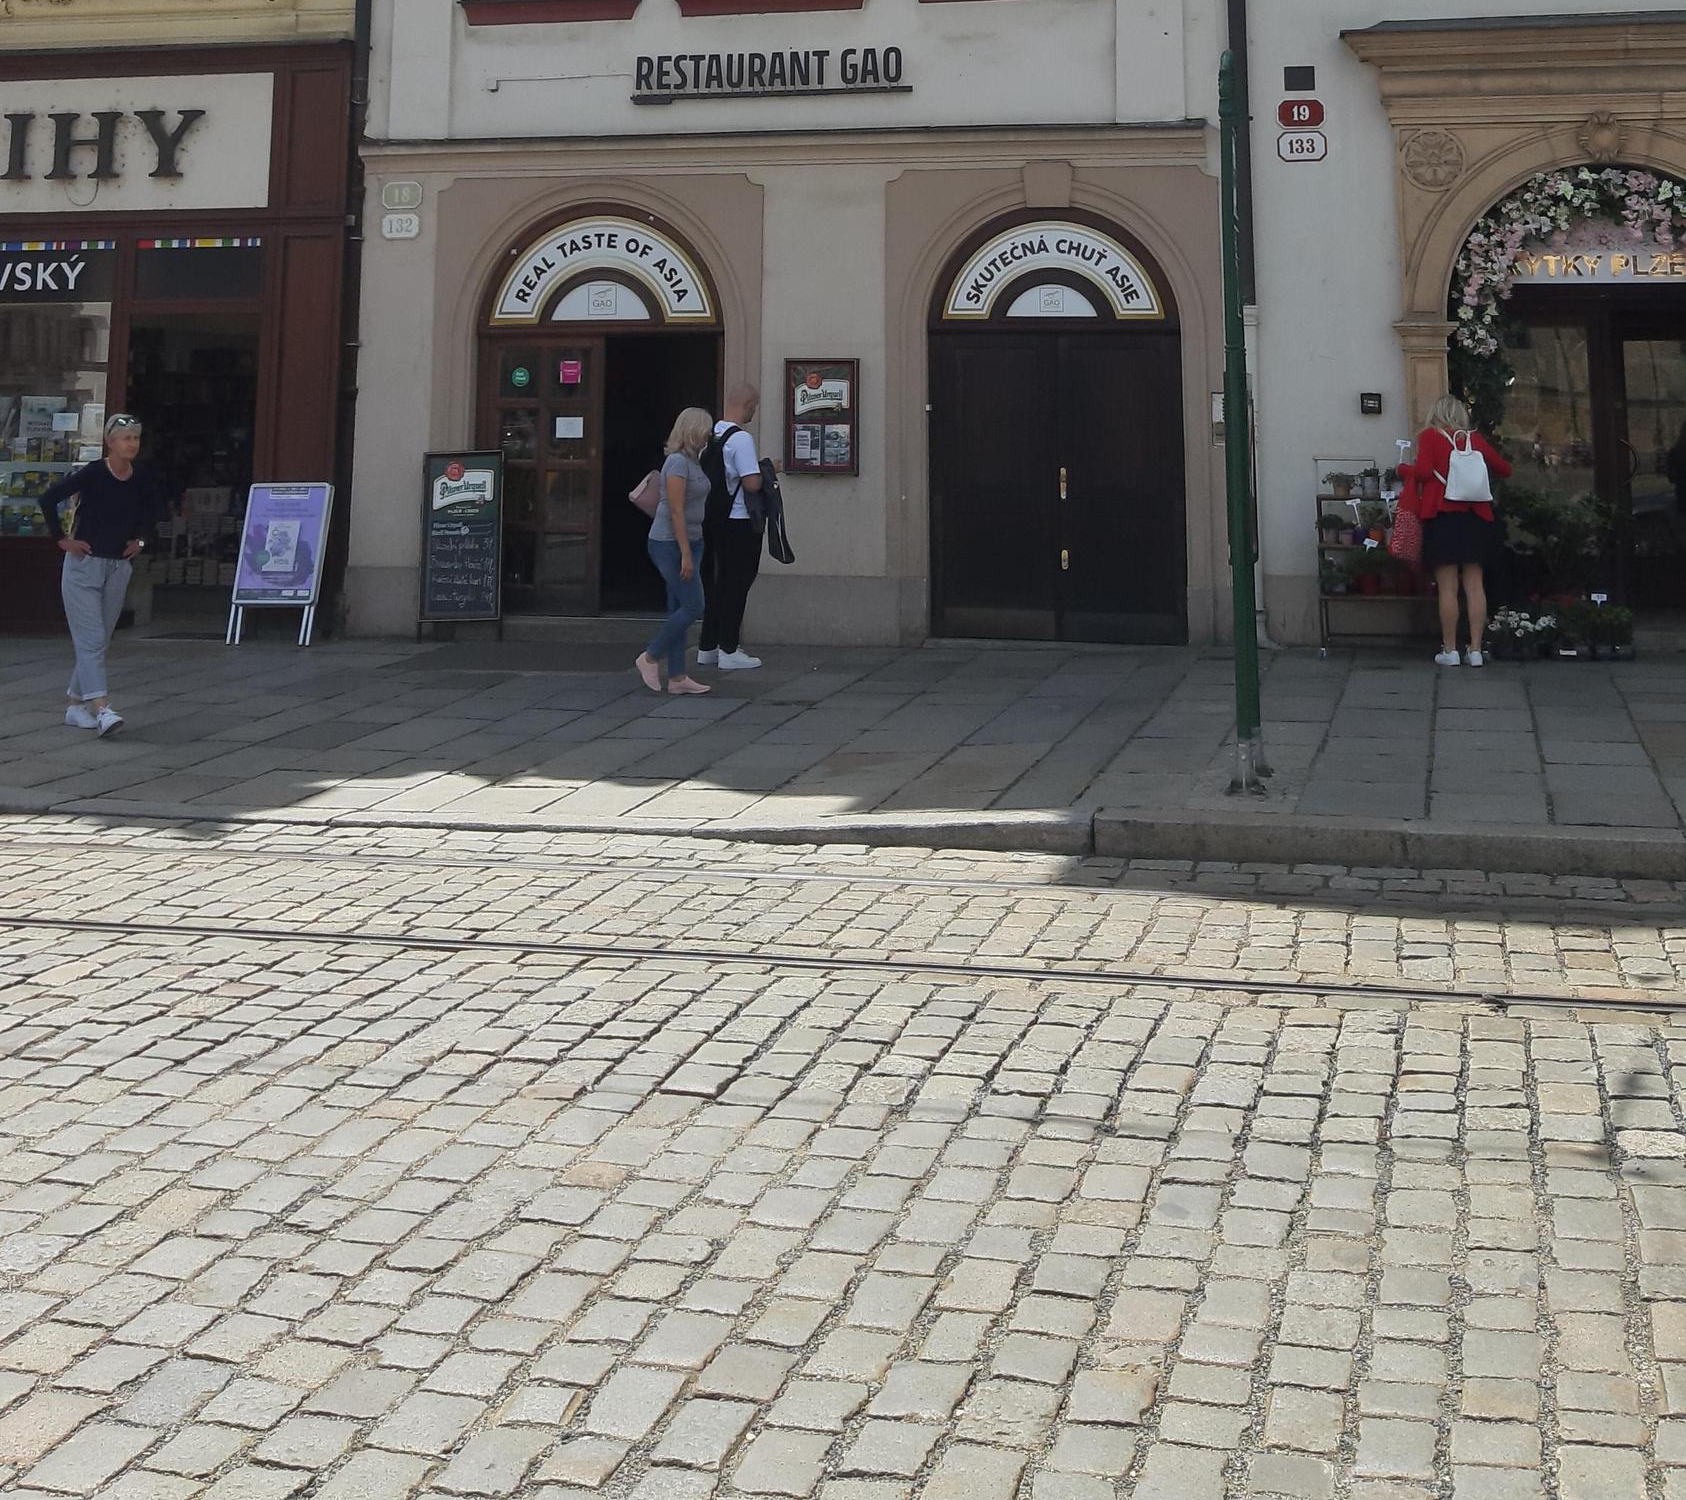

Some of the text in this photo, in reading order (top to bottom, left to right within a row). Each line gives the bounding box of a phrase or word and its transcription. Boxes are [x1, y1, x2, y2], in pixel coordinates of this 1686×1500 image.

[635, 47, 901, 91] RESTAURANT GAO
[1292, 105, 1310, 121] 19
[0, 110, 206, 180] IHY
[1288, 138, 1315, 154] 133
[393, 188, 410, 203] 18
[388, 218, 413, 234] 132
[515, 233, 689, 303] REAL TASTE OF ASIA
[966, 235, 1140, 304] SKUTEČNÁ CHUŤ ASIE
[592, 299, 613, 308] GAO
[1043, 299, 1061, 307] GAO
